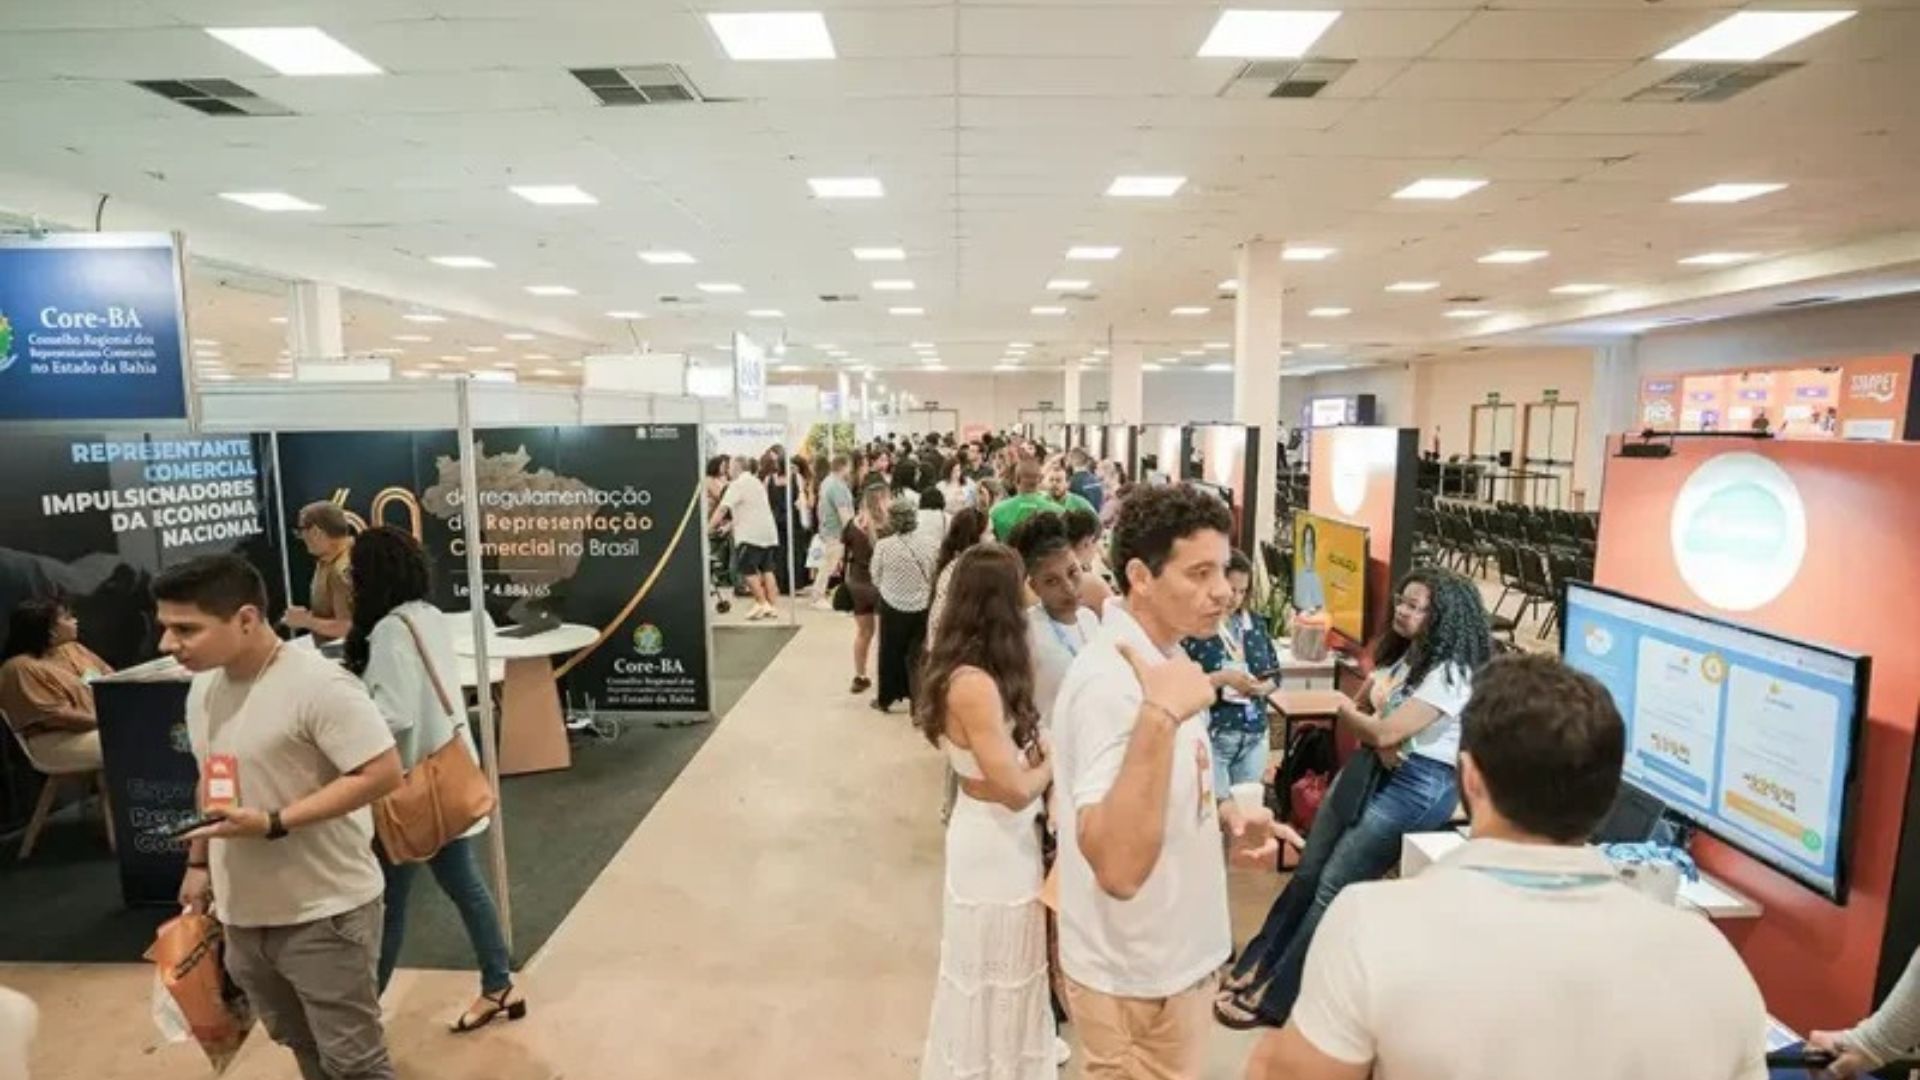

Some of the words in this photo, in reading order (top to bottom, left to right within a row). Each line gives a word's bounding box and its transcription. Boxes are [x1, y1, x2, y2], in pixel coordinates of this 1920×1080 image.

[40, 305, 143, 329] Core-BA
[31, 363, 49, 374] no
[52, 361, 97, 374] Estado
[100, 361, 116, 374] da
[119, 360, 157, 374] Bahia
[71, 440, 250, 463] REPRESENTANTE
[144, 459, 257, 482] COMERCIAL
[479, 486, 651, 510] regulamentação
[111, 511, 147, 532] DA
[153, 499, 258, 527] ECONOMIA
[448, 513, 466, 531] d
[486, 512, 653, 534] Representação
[163, 518, 263, 548] NACIONAL
[450, 537, 556, 556] Cmercial
[558, 541, 584, 556] no
[589, 538, 640, 556] Brasil
[613, 657, 685, 674] Core-BA
